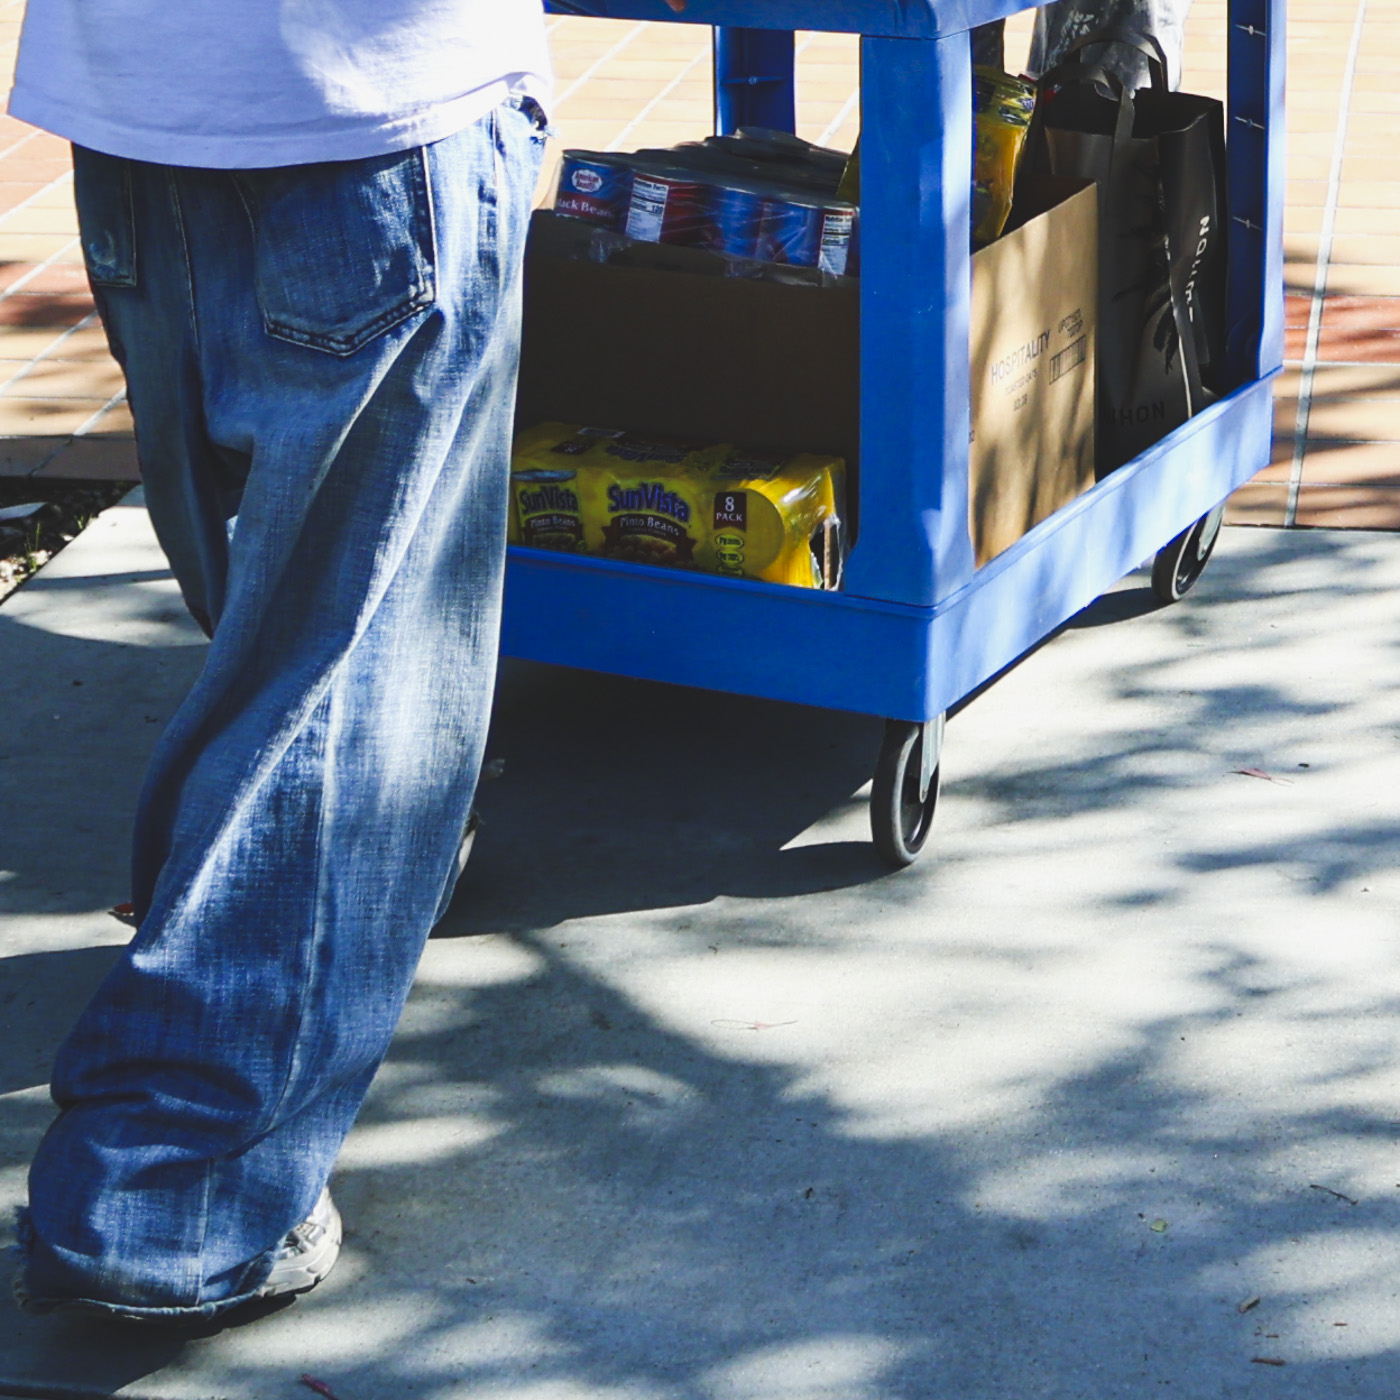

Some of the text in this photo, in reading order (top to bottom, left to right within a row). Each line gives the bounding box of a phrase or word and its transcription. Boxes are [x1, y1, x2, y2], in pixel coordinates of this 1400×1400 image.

[558, 198, 579, 211] lack
[990, 329, 1051, 385] HOSPITALITY
[519, 484, 579, 515] SunVista
[607, 482, 691, 523] SunVista
[724, 496, 735, 513] 8
[552, 515, 576, 528] Beans
[716, 511, 743, 522] PACK
[619, 516, 680, 537] Pinto Beans
